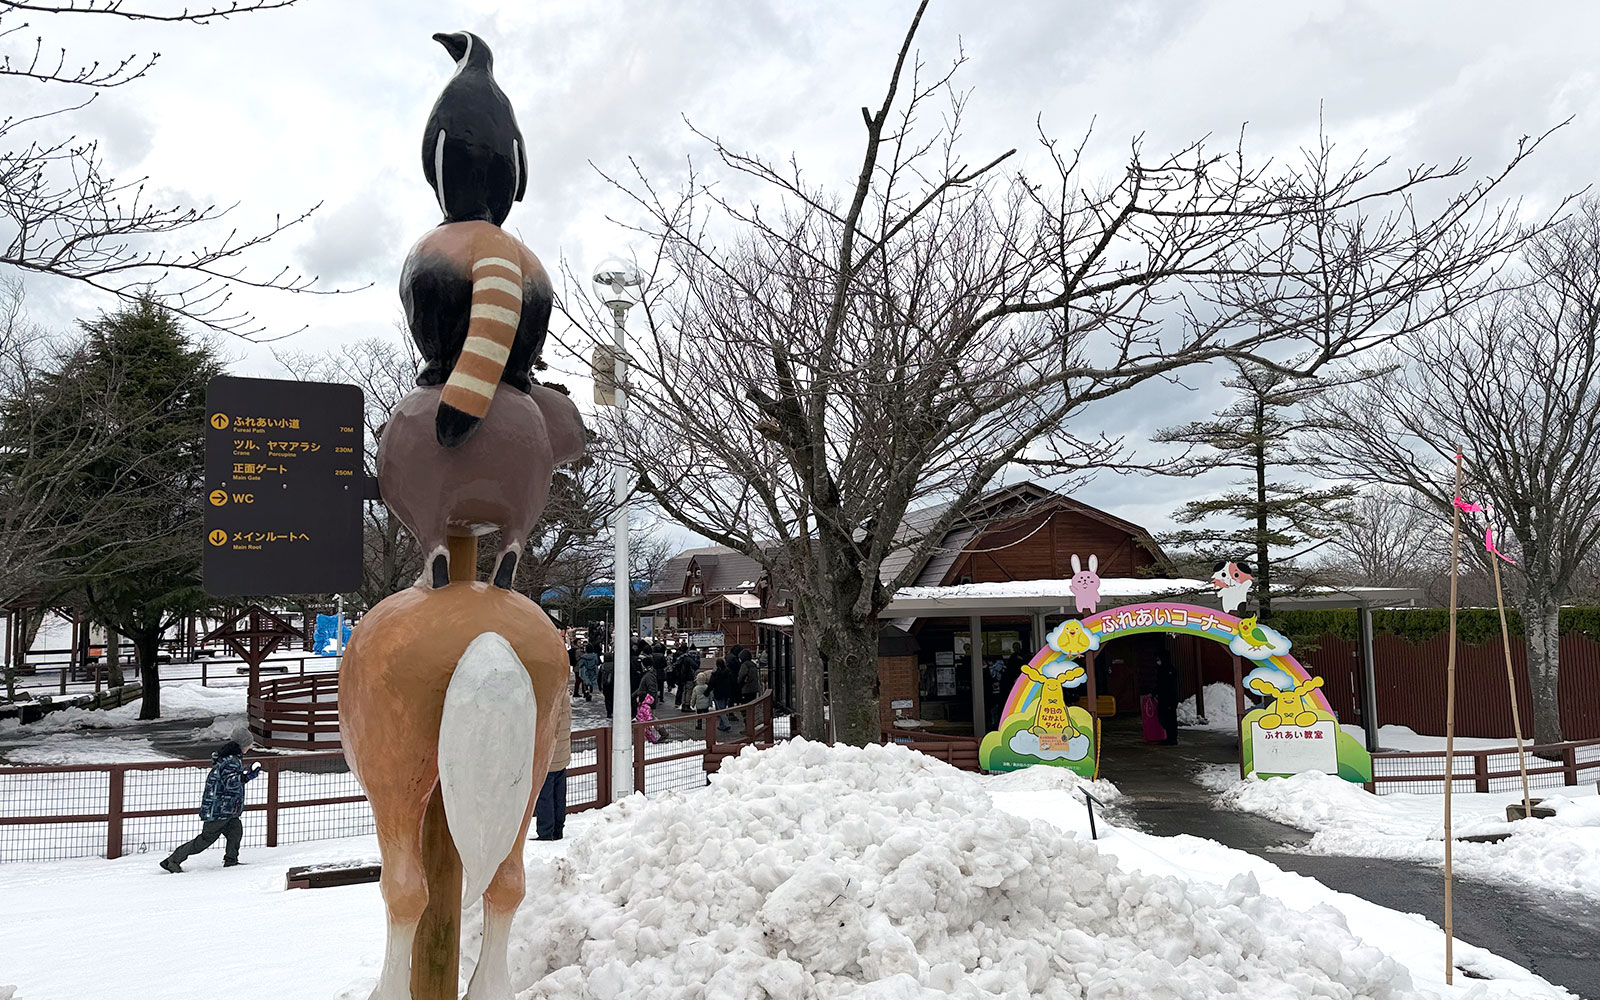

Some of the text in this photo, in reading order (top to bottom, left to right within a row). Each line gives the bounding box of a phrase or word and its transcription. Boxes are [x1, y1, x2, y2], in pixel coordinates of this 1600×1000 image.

[233, 416, 300, 429] ふれあい小道
[232, 463, 288, 474] 正面ゲート
[232, 493, 254, 504] WC
[232, 531, 310, 542] メインルートへ
[1101, 608, 1233, 634] ふれあいコーナー
[1043, 707, 1063, 715] 今日の
[1264, 730, 1324, 740] ふれあい教室
